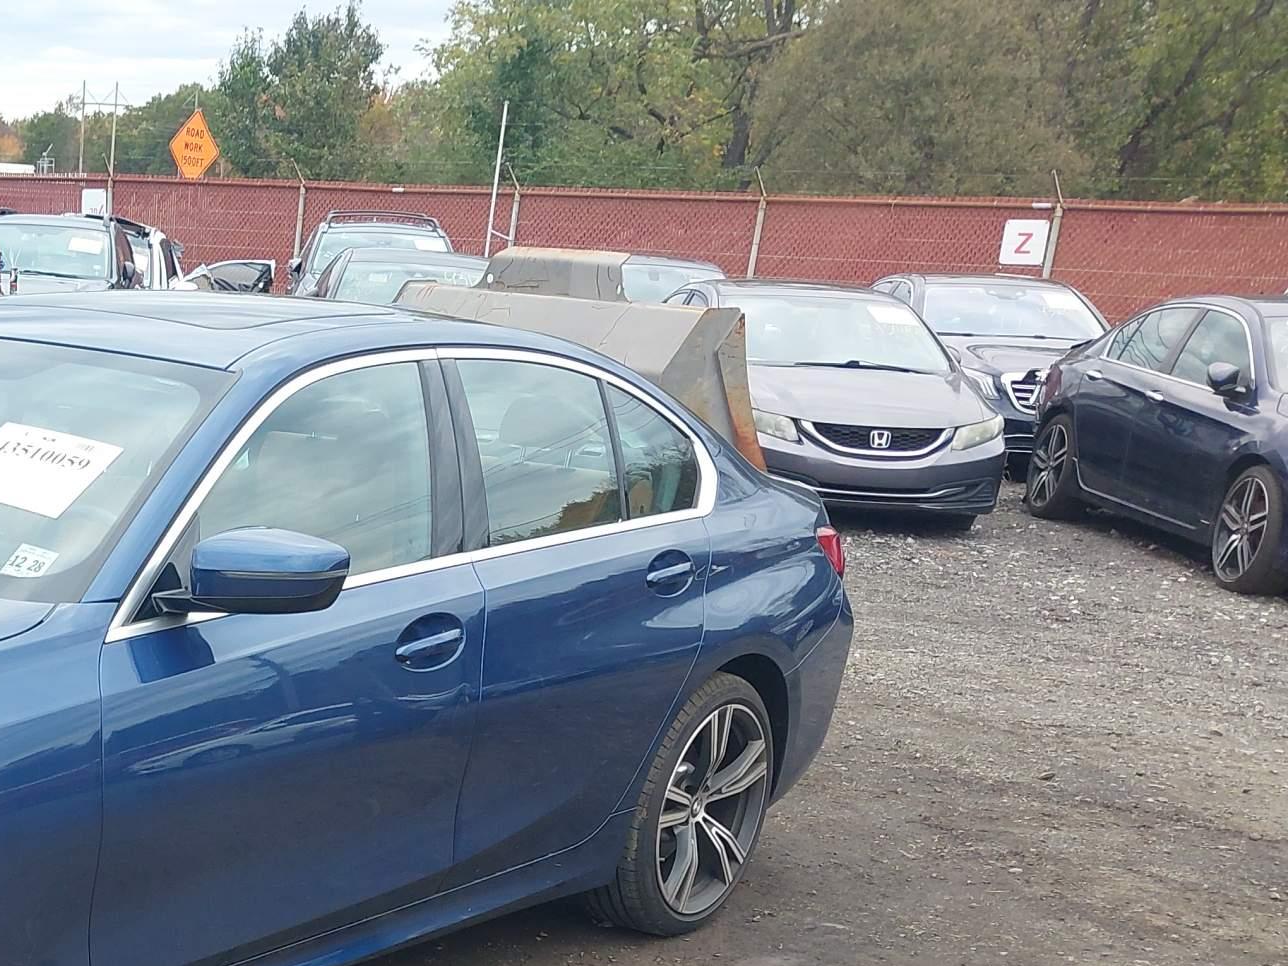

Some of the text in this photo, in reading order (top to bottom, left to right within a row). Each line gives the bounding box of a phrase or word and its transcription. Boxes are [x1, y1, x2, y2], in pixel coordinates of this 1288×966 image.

[186, 127, 205, 140] ROAD
[184, 142, 203, 153] WORK
[1014, 232, 1034, 254] Z
[8, 554, 28, 568] 12
[26, 559, 46, 573] 28
